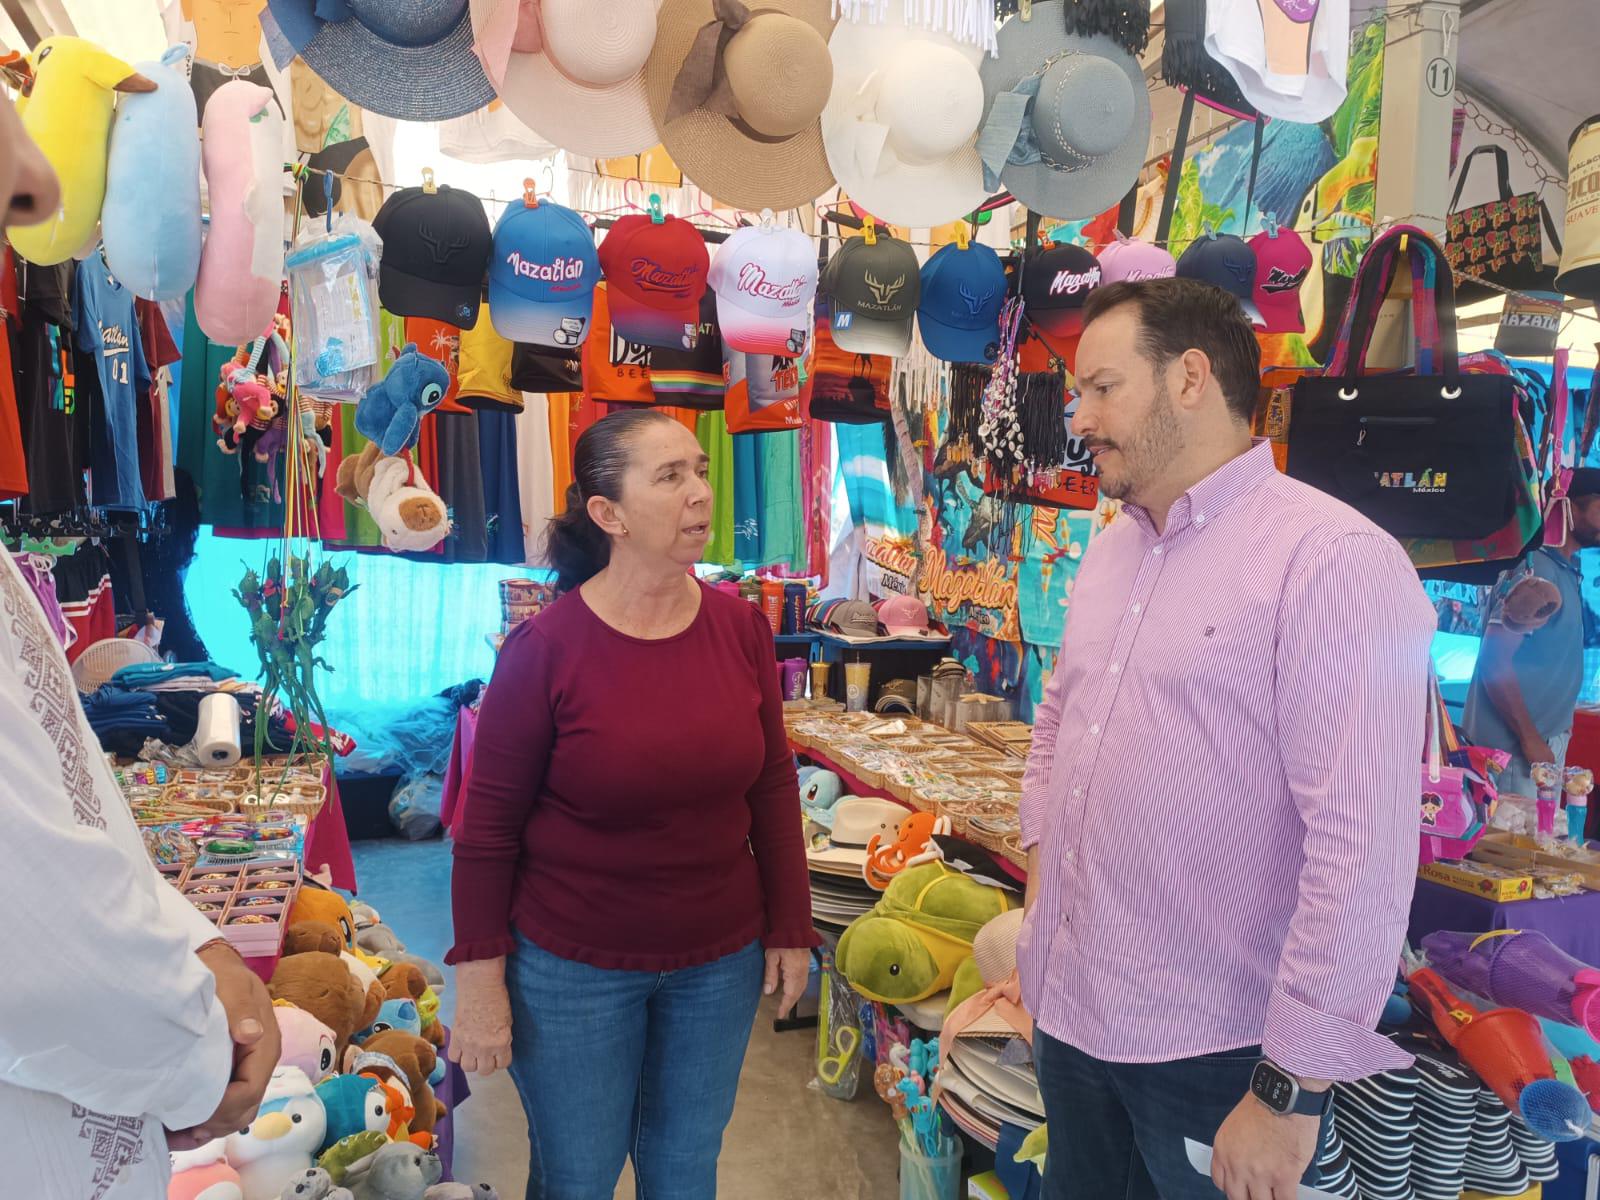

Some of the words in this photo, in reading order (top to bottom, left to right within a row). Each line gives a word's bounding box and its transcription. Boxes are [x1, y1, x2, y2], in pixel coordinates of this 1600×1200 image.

[1431, 64, 1450, 92] 11
[506, 252, 584, 281] Mazatlán
[857, 300, 902, 313] MAZATLÁN
[836, 313, 851, 328] M
[112, 358, 129, 385] 01
[919, 545, 1017, 614] Mazatlán
[1423, 865, 1451, 881] Rosa
